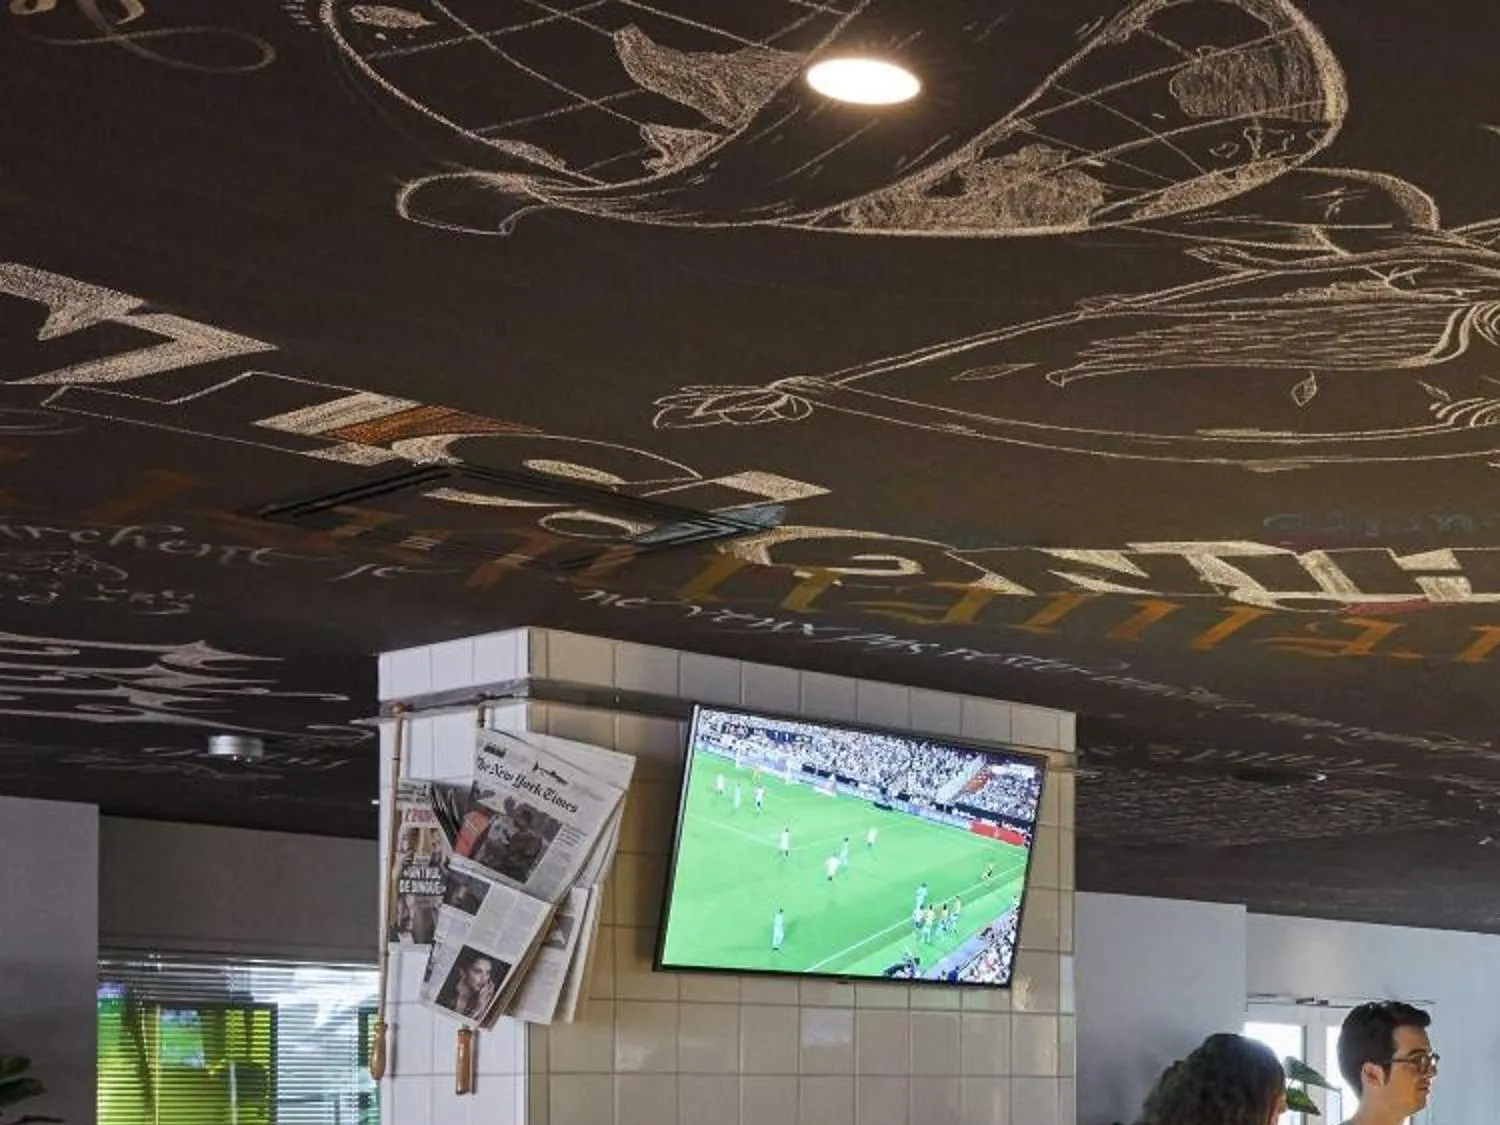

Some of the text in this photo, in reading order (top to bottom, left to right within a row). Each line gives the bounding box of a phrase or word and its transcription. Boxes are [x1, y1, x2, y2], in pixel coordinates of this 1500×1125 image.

[489, 763, 515, 783] New
[512, 773, 543, 797] York
[542, 787, 579, 813] Times
